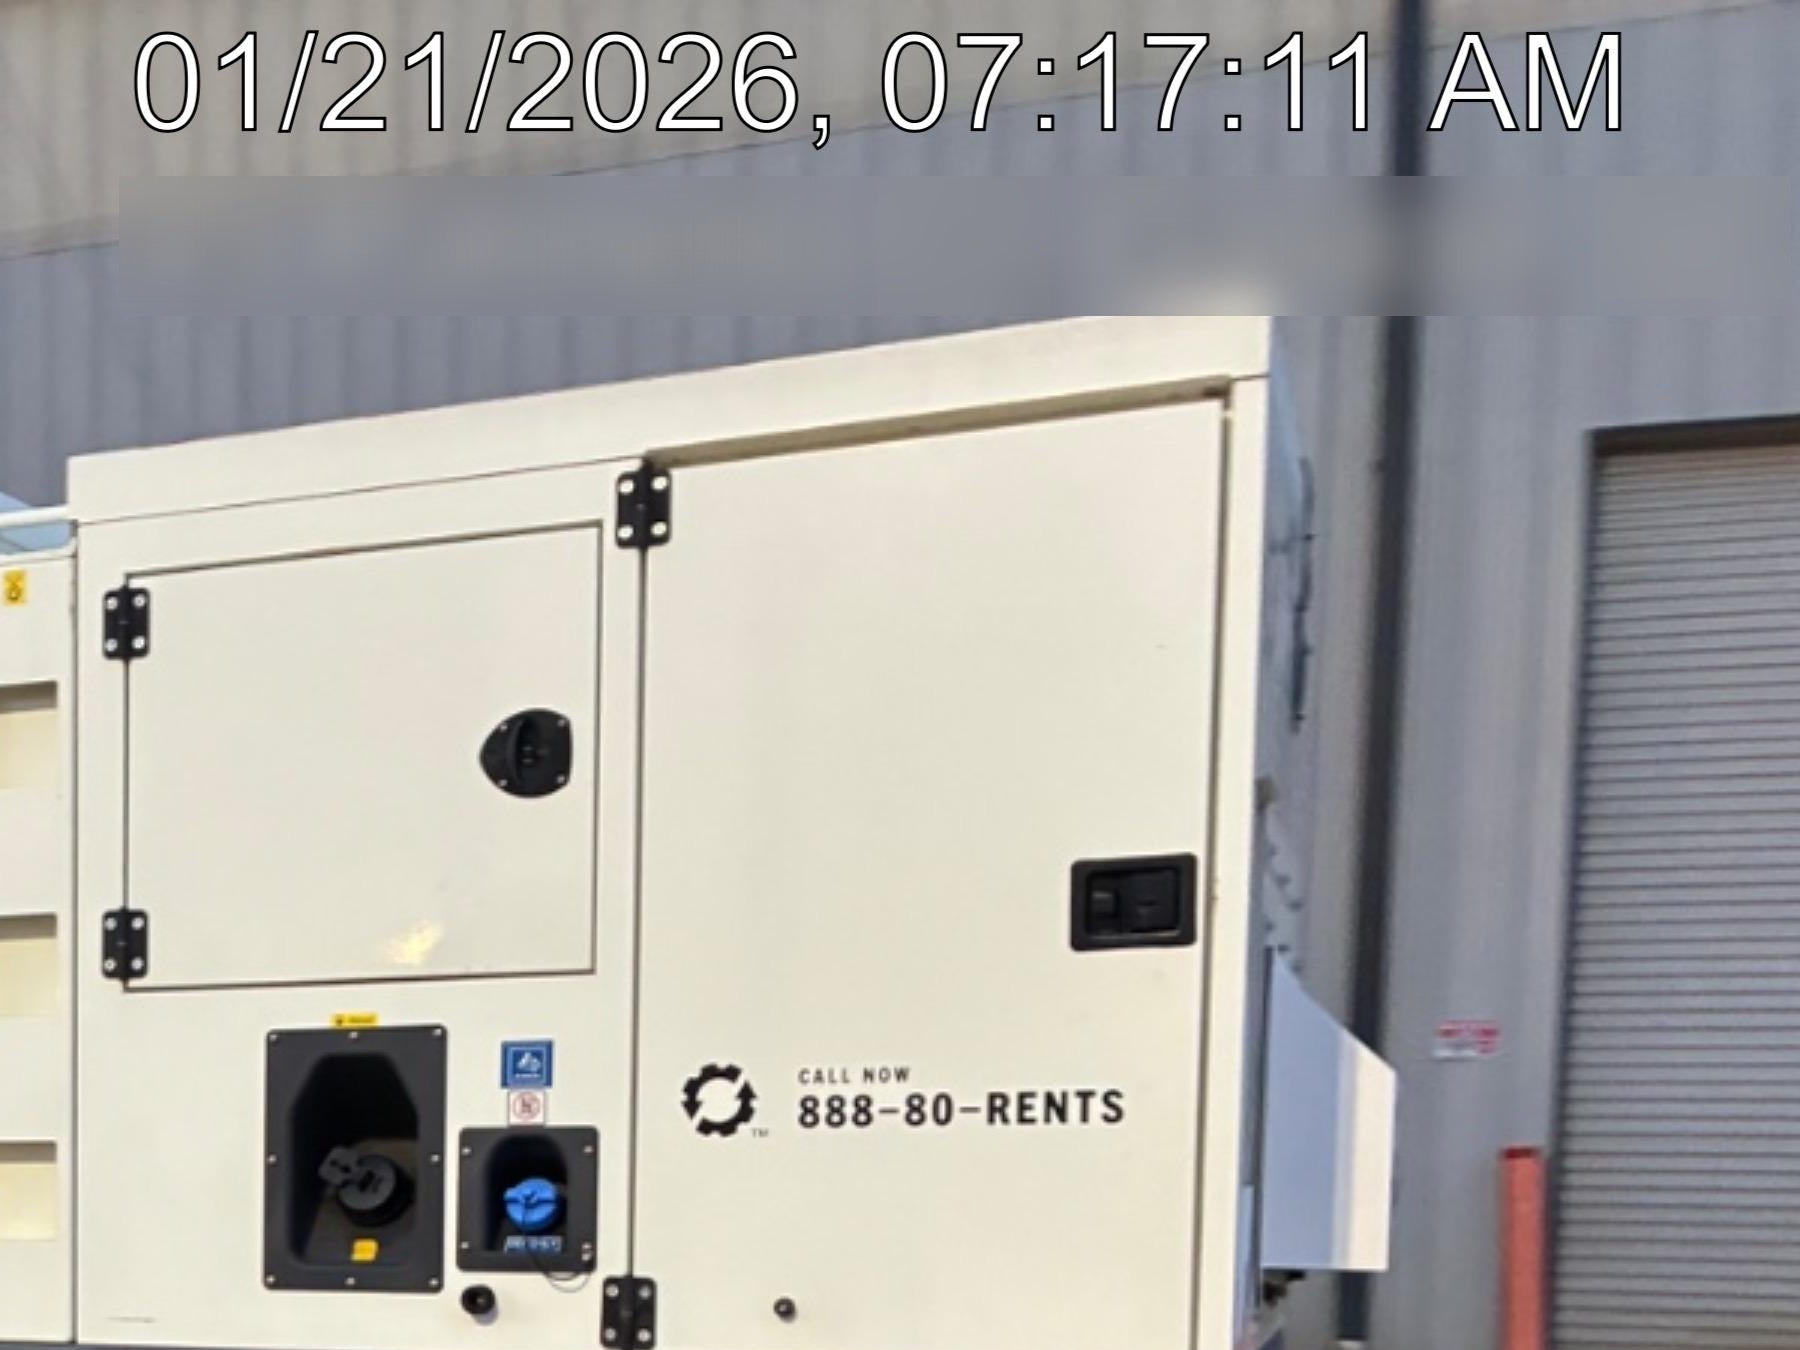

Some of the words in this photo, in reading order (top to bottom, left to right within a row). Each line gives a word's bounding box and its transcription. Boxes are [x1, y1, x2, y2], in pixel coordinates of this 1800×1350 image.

[798, 1067, 852, 1085] CALL
[862, 1066, 912, 1084] NOW
[798, 1089, 1126, 1129] 888-80-RENTS
